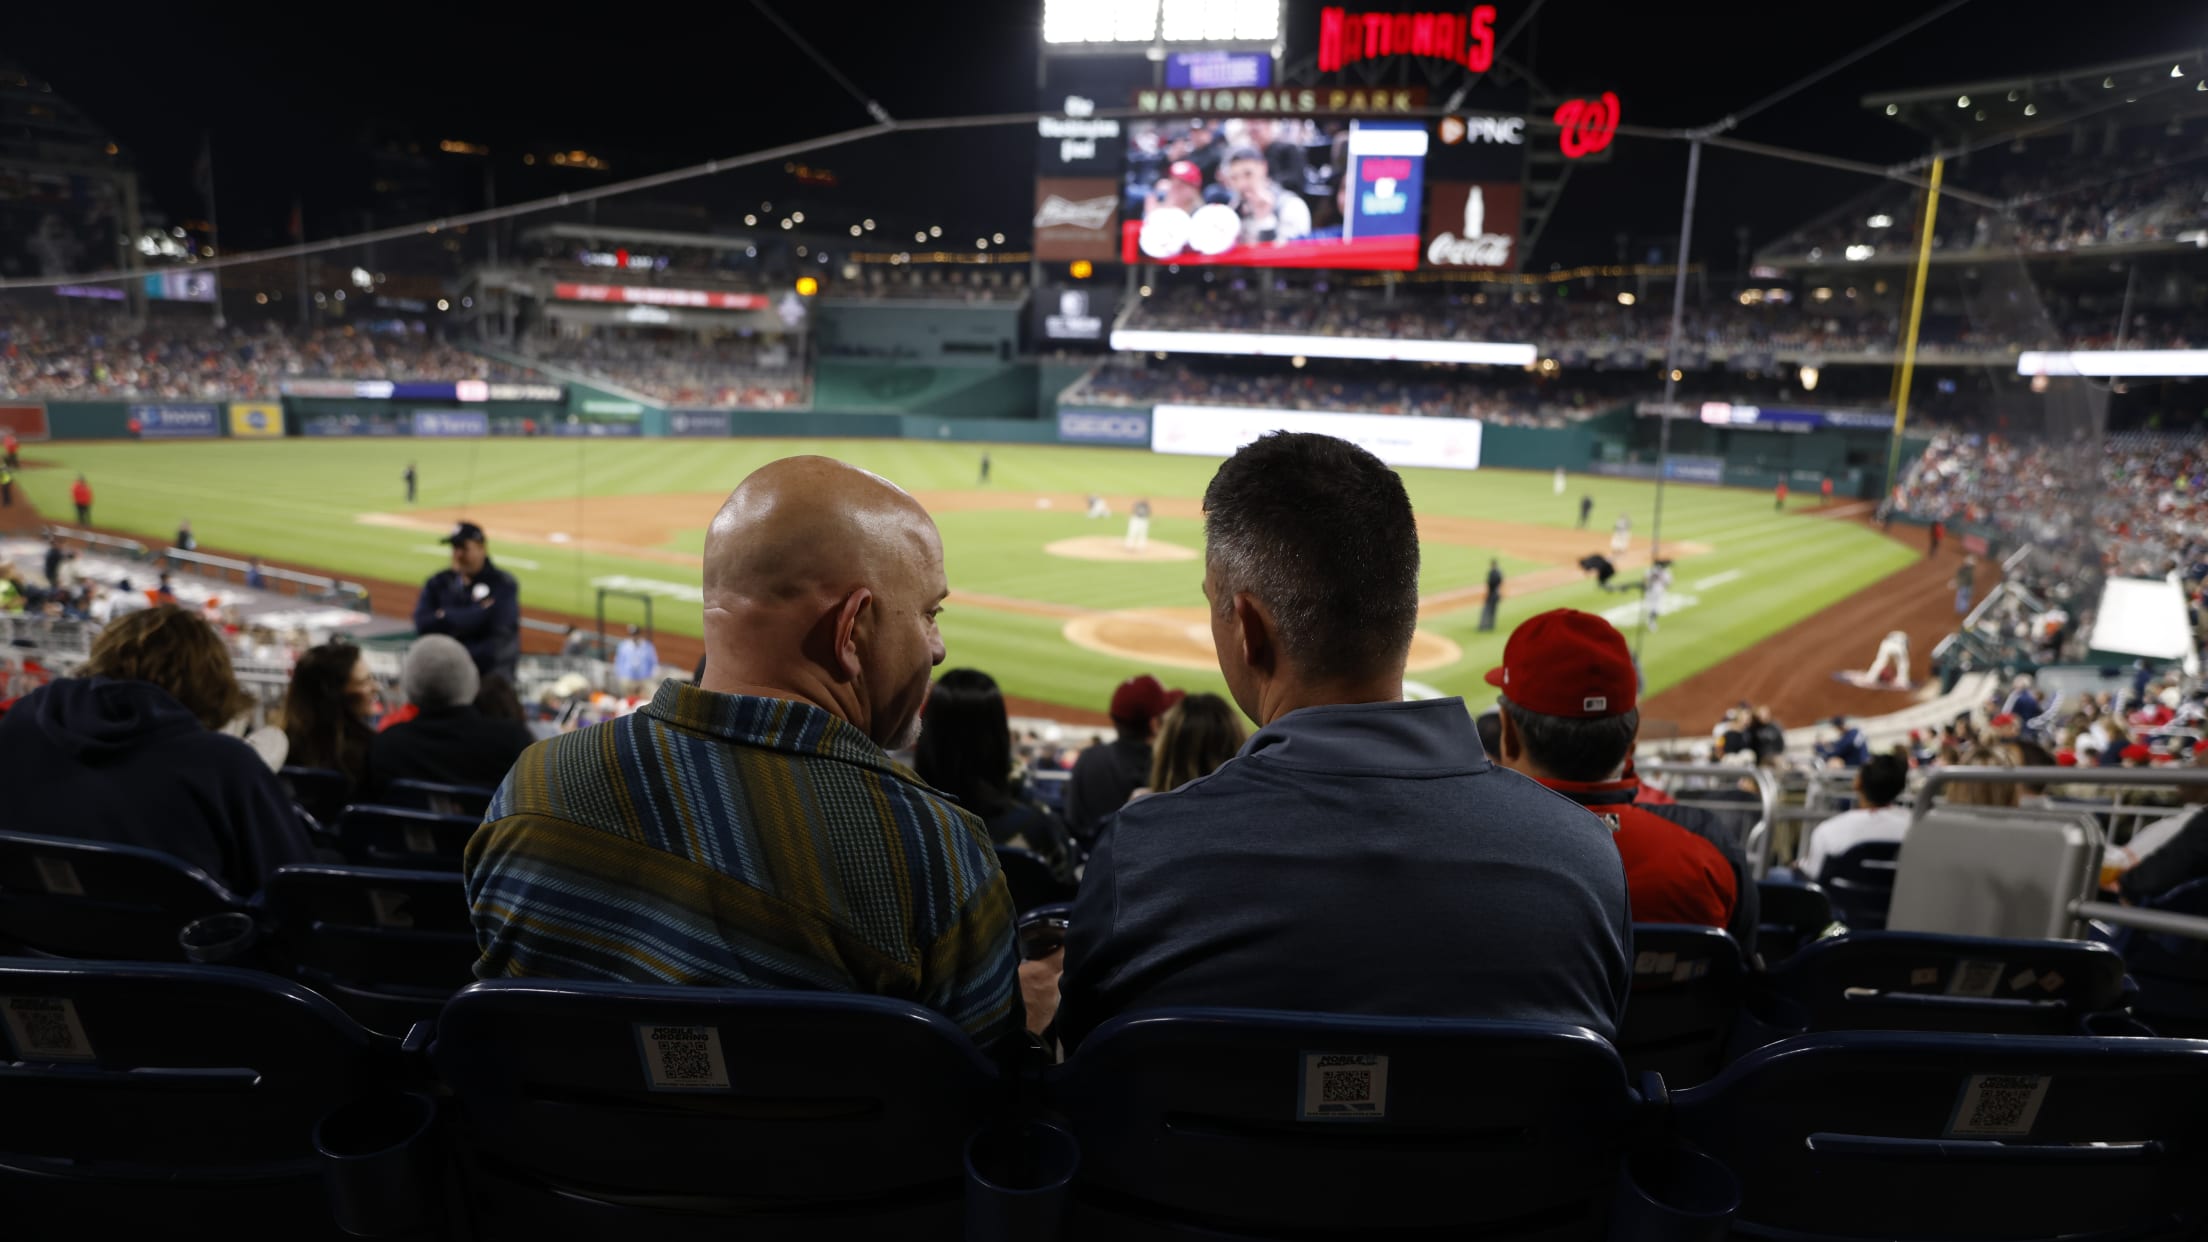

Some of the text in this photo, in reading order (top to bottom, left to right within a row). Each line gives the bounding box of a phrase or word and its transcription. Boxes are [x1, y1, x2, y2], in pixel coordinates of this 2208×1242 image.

[1318, 5, 1496, 72] NATIONALS
[1138, 90, 1411, 112] NATIONALS PARK
[1467, 116, 1525, 144] PNC
[651, 1033, 709, 1041] ORDERING
[653, 1026, 694, 1034] MOBILE
